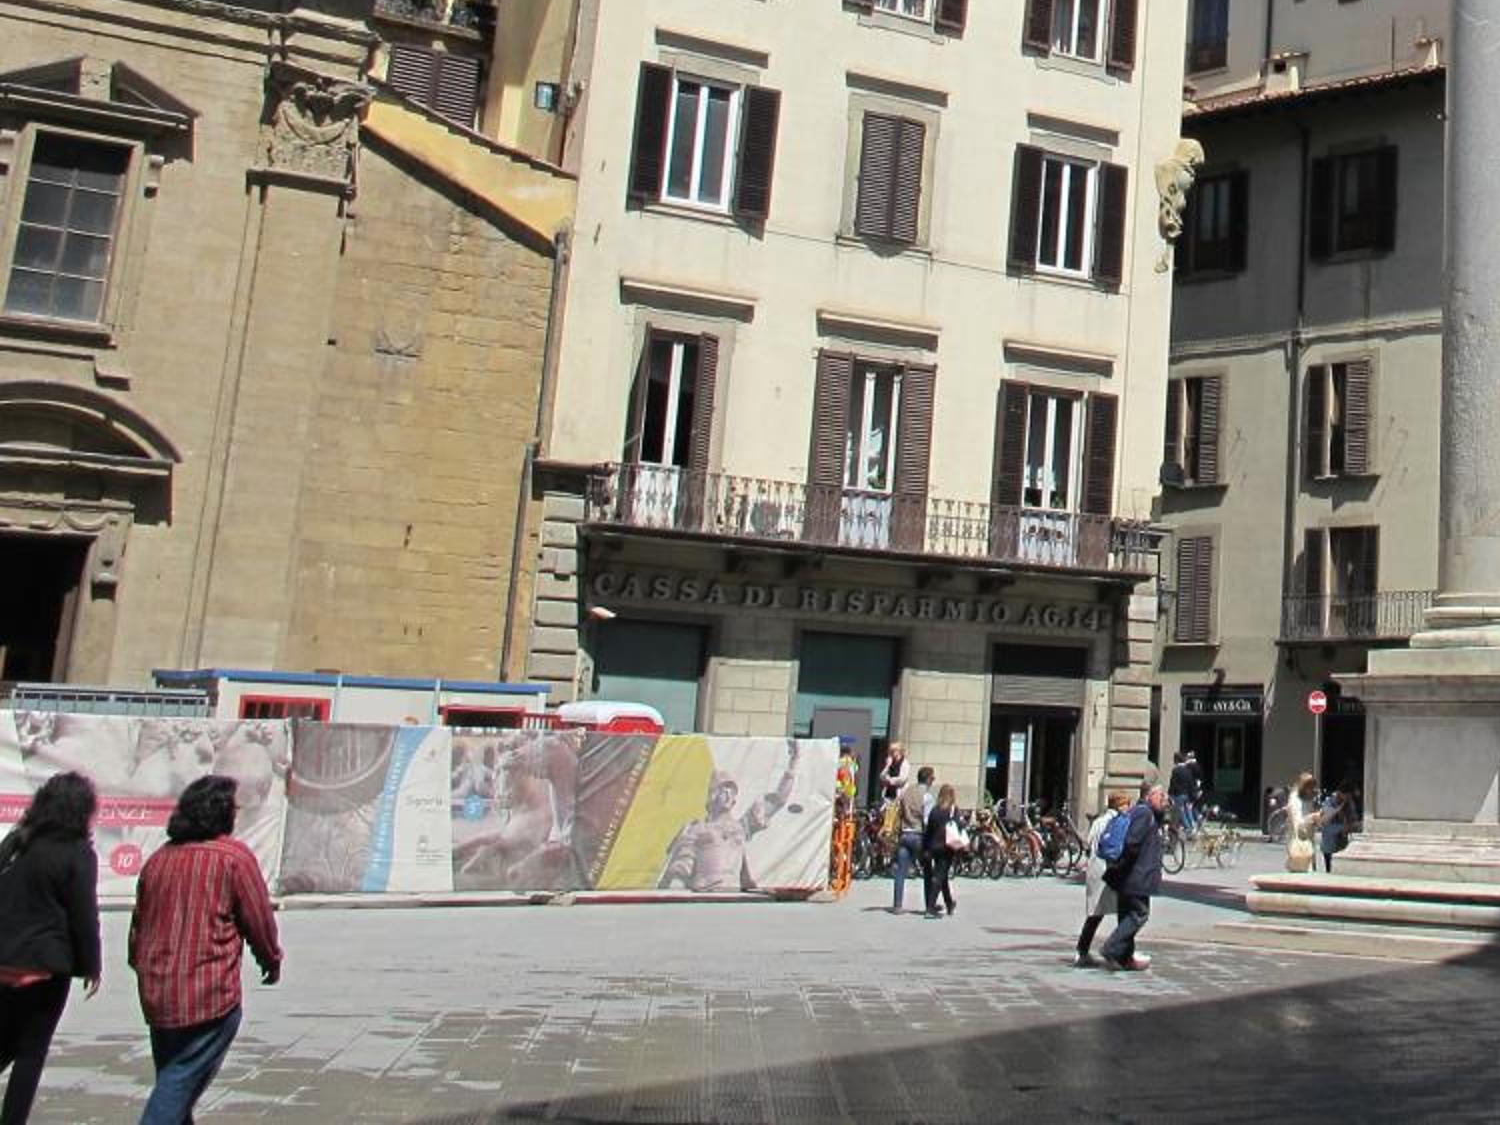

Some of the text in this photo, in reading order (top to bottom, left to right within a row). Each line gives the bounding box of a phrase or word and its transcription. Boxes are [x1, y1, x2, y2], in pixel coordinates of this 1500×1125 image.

[593, 571, 728, 606] CASSA
[743, 585, 785, 609] DI
[800, 586, 1011, 623] RISPARMIO
